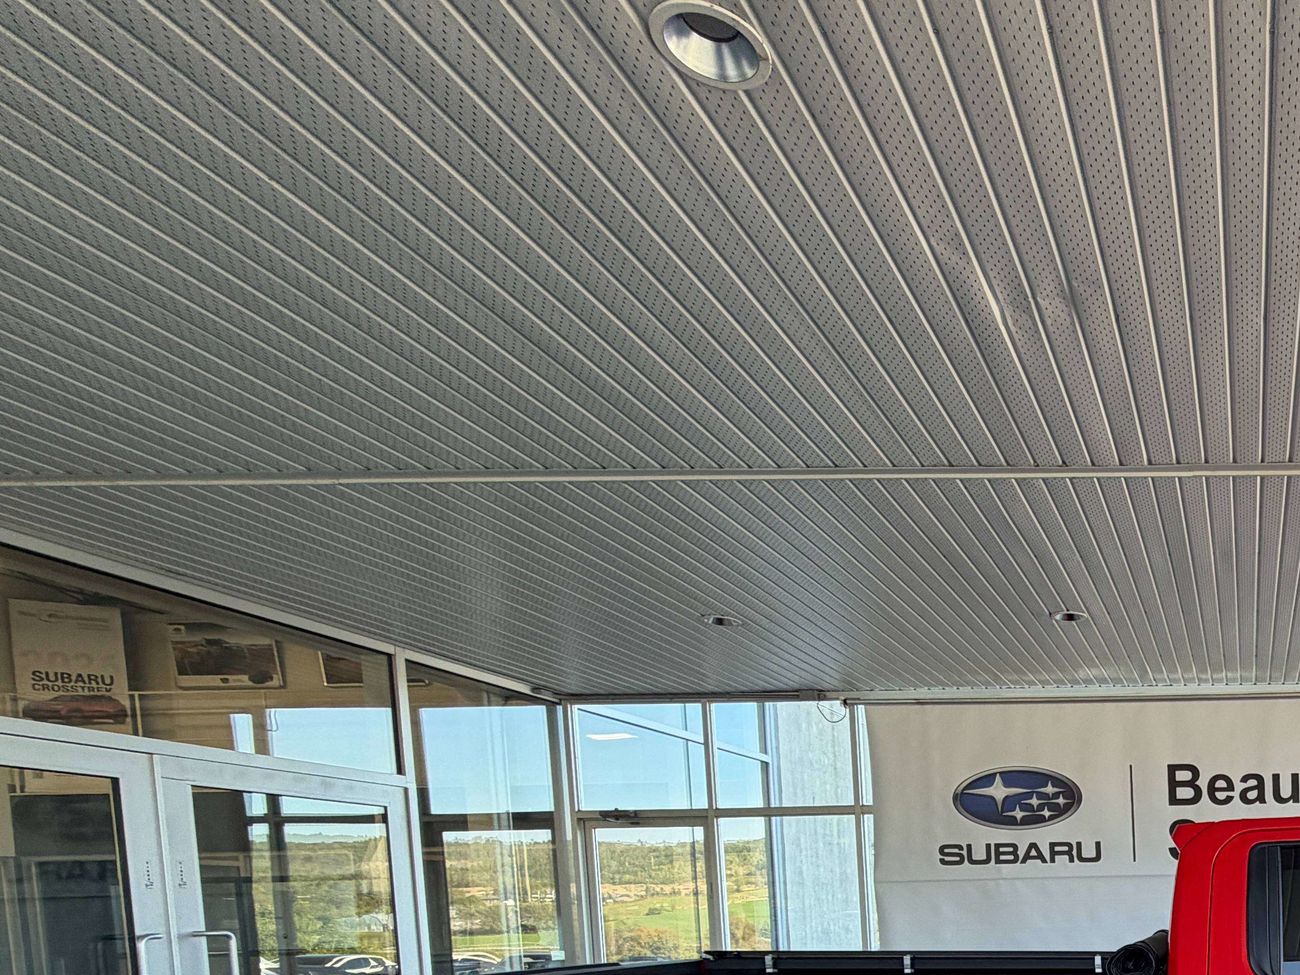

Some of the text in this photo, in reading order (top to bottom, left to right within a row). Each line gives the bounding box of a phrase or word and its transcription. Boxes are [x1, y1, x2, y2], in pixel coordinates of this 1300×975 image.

[31, 670, 114, 686] SUBARU
[31, 683, 113, 693] CROSSTREK
[938, 841, 1102, 866] SUBARU
